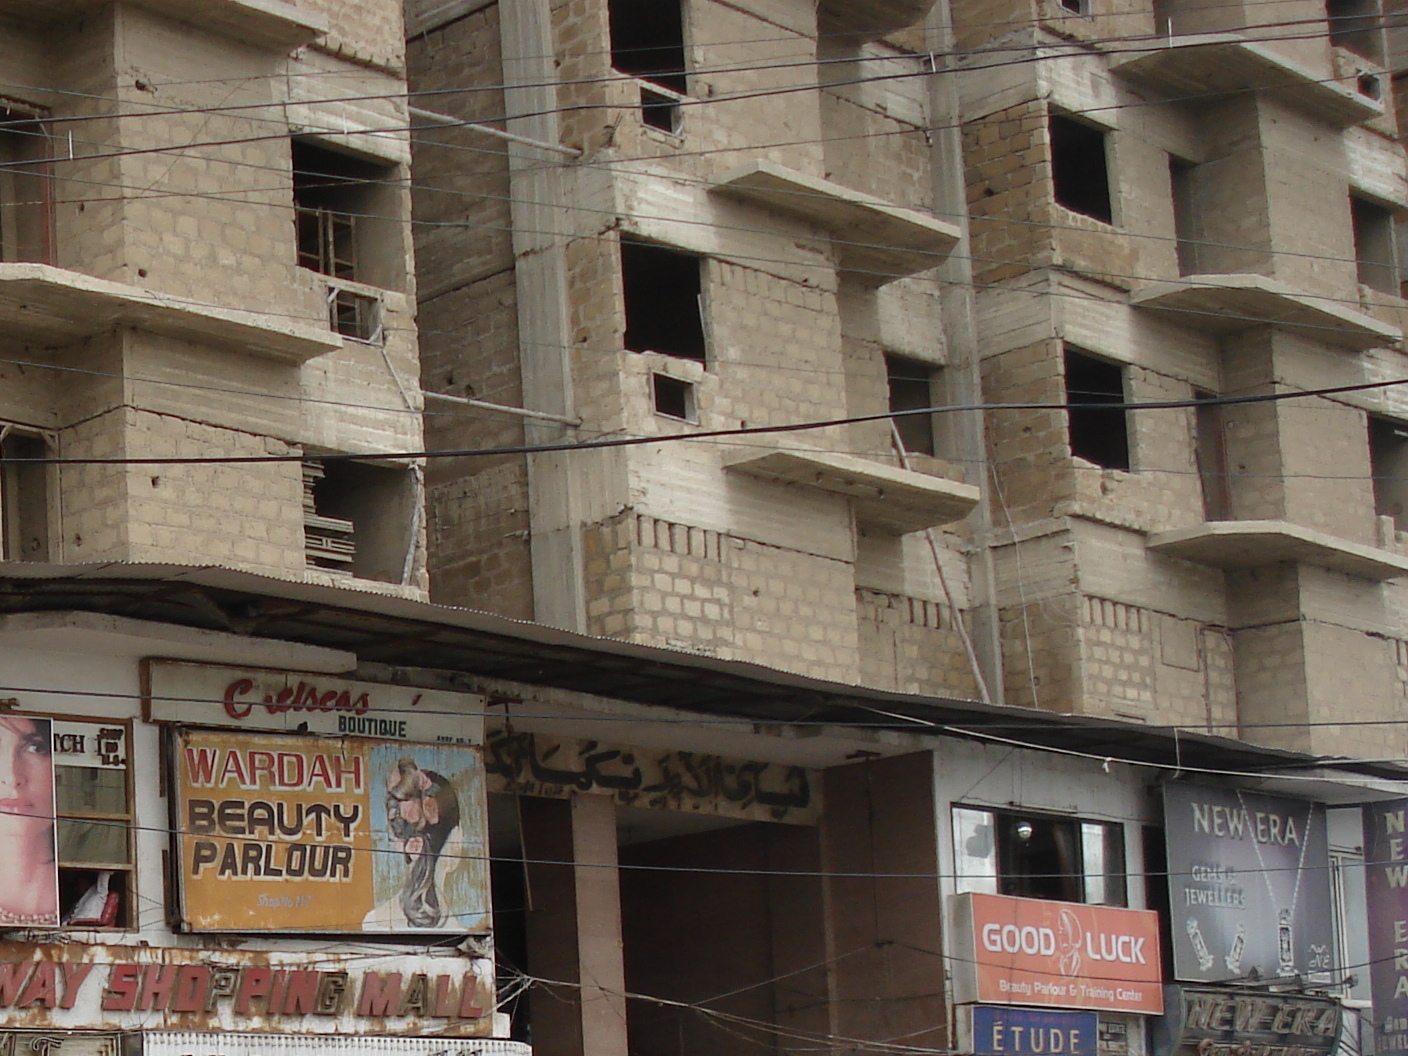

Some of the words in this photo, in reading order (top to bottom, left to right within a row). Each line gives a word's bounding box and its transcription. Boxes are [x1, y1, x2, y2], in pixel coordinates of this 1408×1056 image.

[338, 715, 407, 738] BOUTIQUE
[186, 747, 365, 794] WARDAH
[188, 798, 361, 841] BEAUTY
[1191, 802, 1244, 839] NEW
[1254, 811, 1300, 848] ERA
[192, 840, 353, 882] PARLOUR
[1192, 865, 1224, 884] GEMS
[1184, 887, 1246, 909] JEWELLERS
[982, 923, 1056, 957] GOOD
[1085, 932, 1147, 965] LUCK
[101, 962, 348, 1017] SHOPPING
[356, 970, 492, 1019] MALL
[999, 979, 1031, 995] Beauty
[1033, 981, 1067, 996] Parlour
[1069, 984, 1078, 997] &
[1080, 985, 1114, 1002] Training
[1116, 988, 1143, 1002] Center
[992, 1021, 1081, 1054] ÉTUDE
[1189, 999, 1265, 1034] NEW
[1271, 1003, 1338, 1037] ERA
